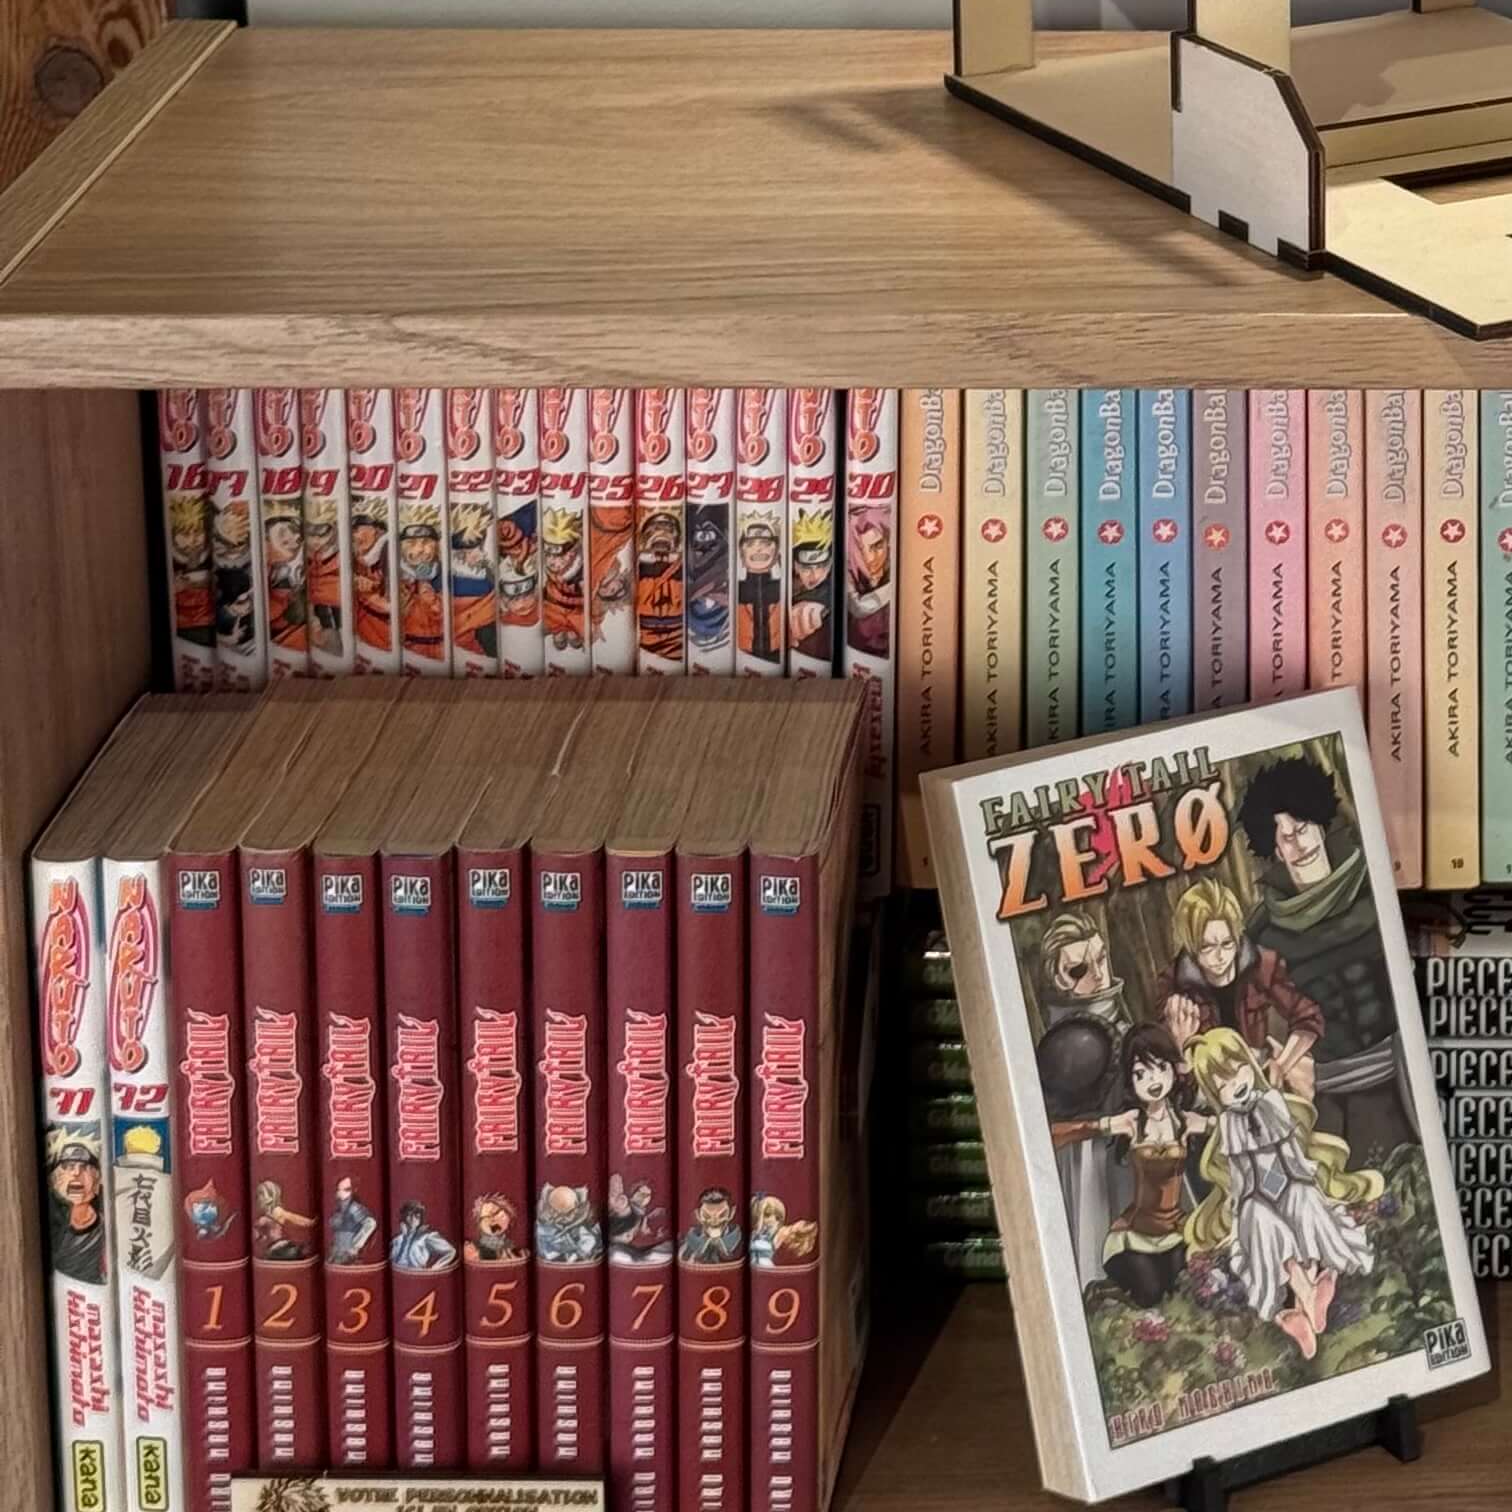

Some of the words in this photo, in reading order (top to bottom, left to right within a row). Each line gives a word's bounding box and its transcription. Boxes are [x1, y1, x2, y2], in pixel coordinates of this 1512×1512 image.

[1043, 389, 1071, 497] DragonBa
[1098, 389, 1125, 500] DragonBa
[1152, 389, 1178, 499] DragonBa
[1203, 389, 1231, 505] DragonBal
[1265, 389, 1292, 500] DragonBa
[1440, 389, 1467, 498] DragonBa
[262, 466, 301, 495] 18
[400, 474, 438, 499] 21
[450, 469, 493, 492] 22
[496, 468, 540, 495] 23
[540, 472, 588, 499] 24
[588, 474, 634, 500] 25
[636, 473, 685, 501] 26
[687, 471, 734, 498] 27
[736, 475, 784, 502] 28
[790, 474, 834, 502] 29
[847, 471, 896, 499] 30
[920, 556, 935, 680] TORIYAMA
[1390, 565, 1401, 686] TORIYAMA
[1448, 559, 1459, 682] TORIYAMA
[920, 685, 933, 756] AKIRA
[1390, 692, 1401, 762] AKIRA
[1448, 687, 1459, 757] AKIRA
[979, 769, 1107, 834] FAIRY
[1130, 745, 1221, 794] TAIL
[49, 1088, 95, 1115] 71
[114, 1084, 168, 1112] 72
[127, 1172, 158, 1272] 七代目火影
[203, 1286, 223, 1332] 1
[263, 1283, 299, 1330] 2
[337, 1288, 372, 1334] 3
[405, 1290, 439, 1338] 4
[479, 1281, 518, 1328] 5
[549, 1283, 585, 1330] 6
[631, 1284, 665, 1332] 7
[695, 1286, 731, 1331] 8
[765, 1288, 800, 1335] 9
[79, 1447, 100, 1510] kana
[142, 1442, 163, 1505] kana
